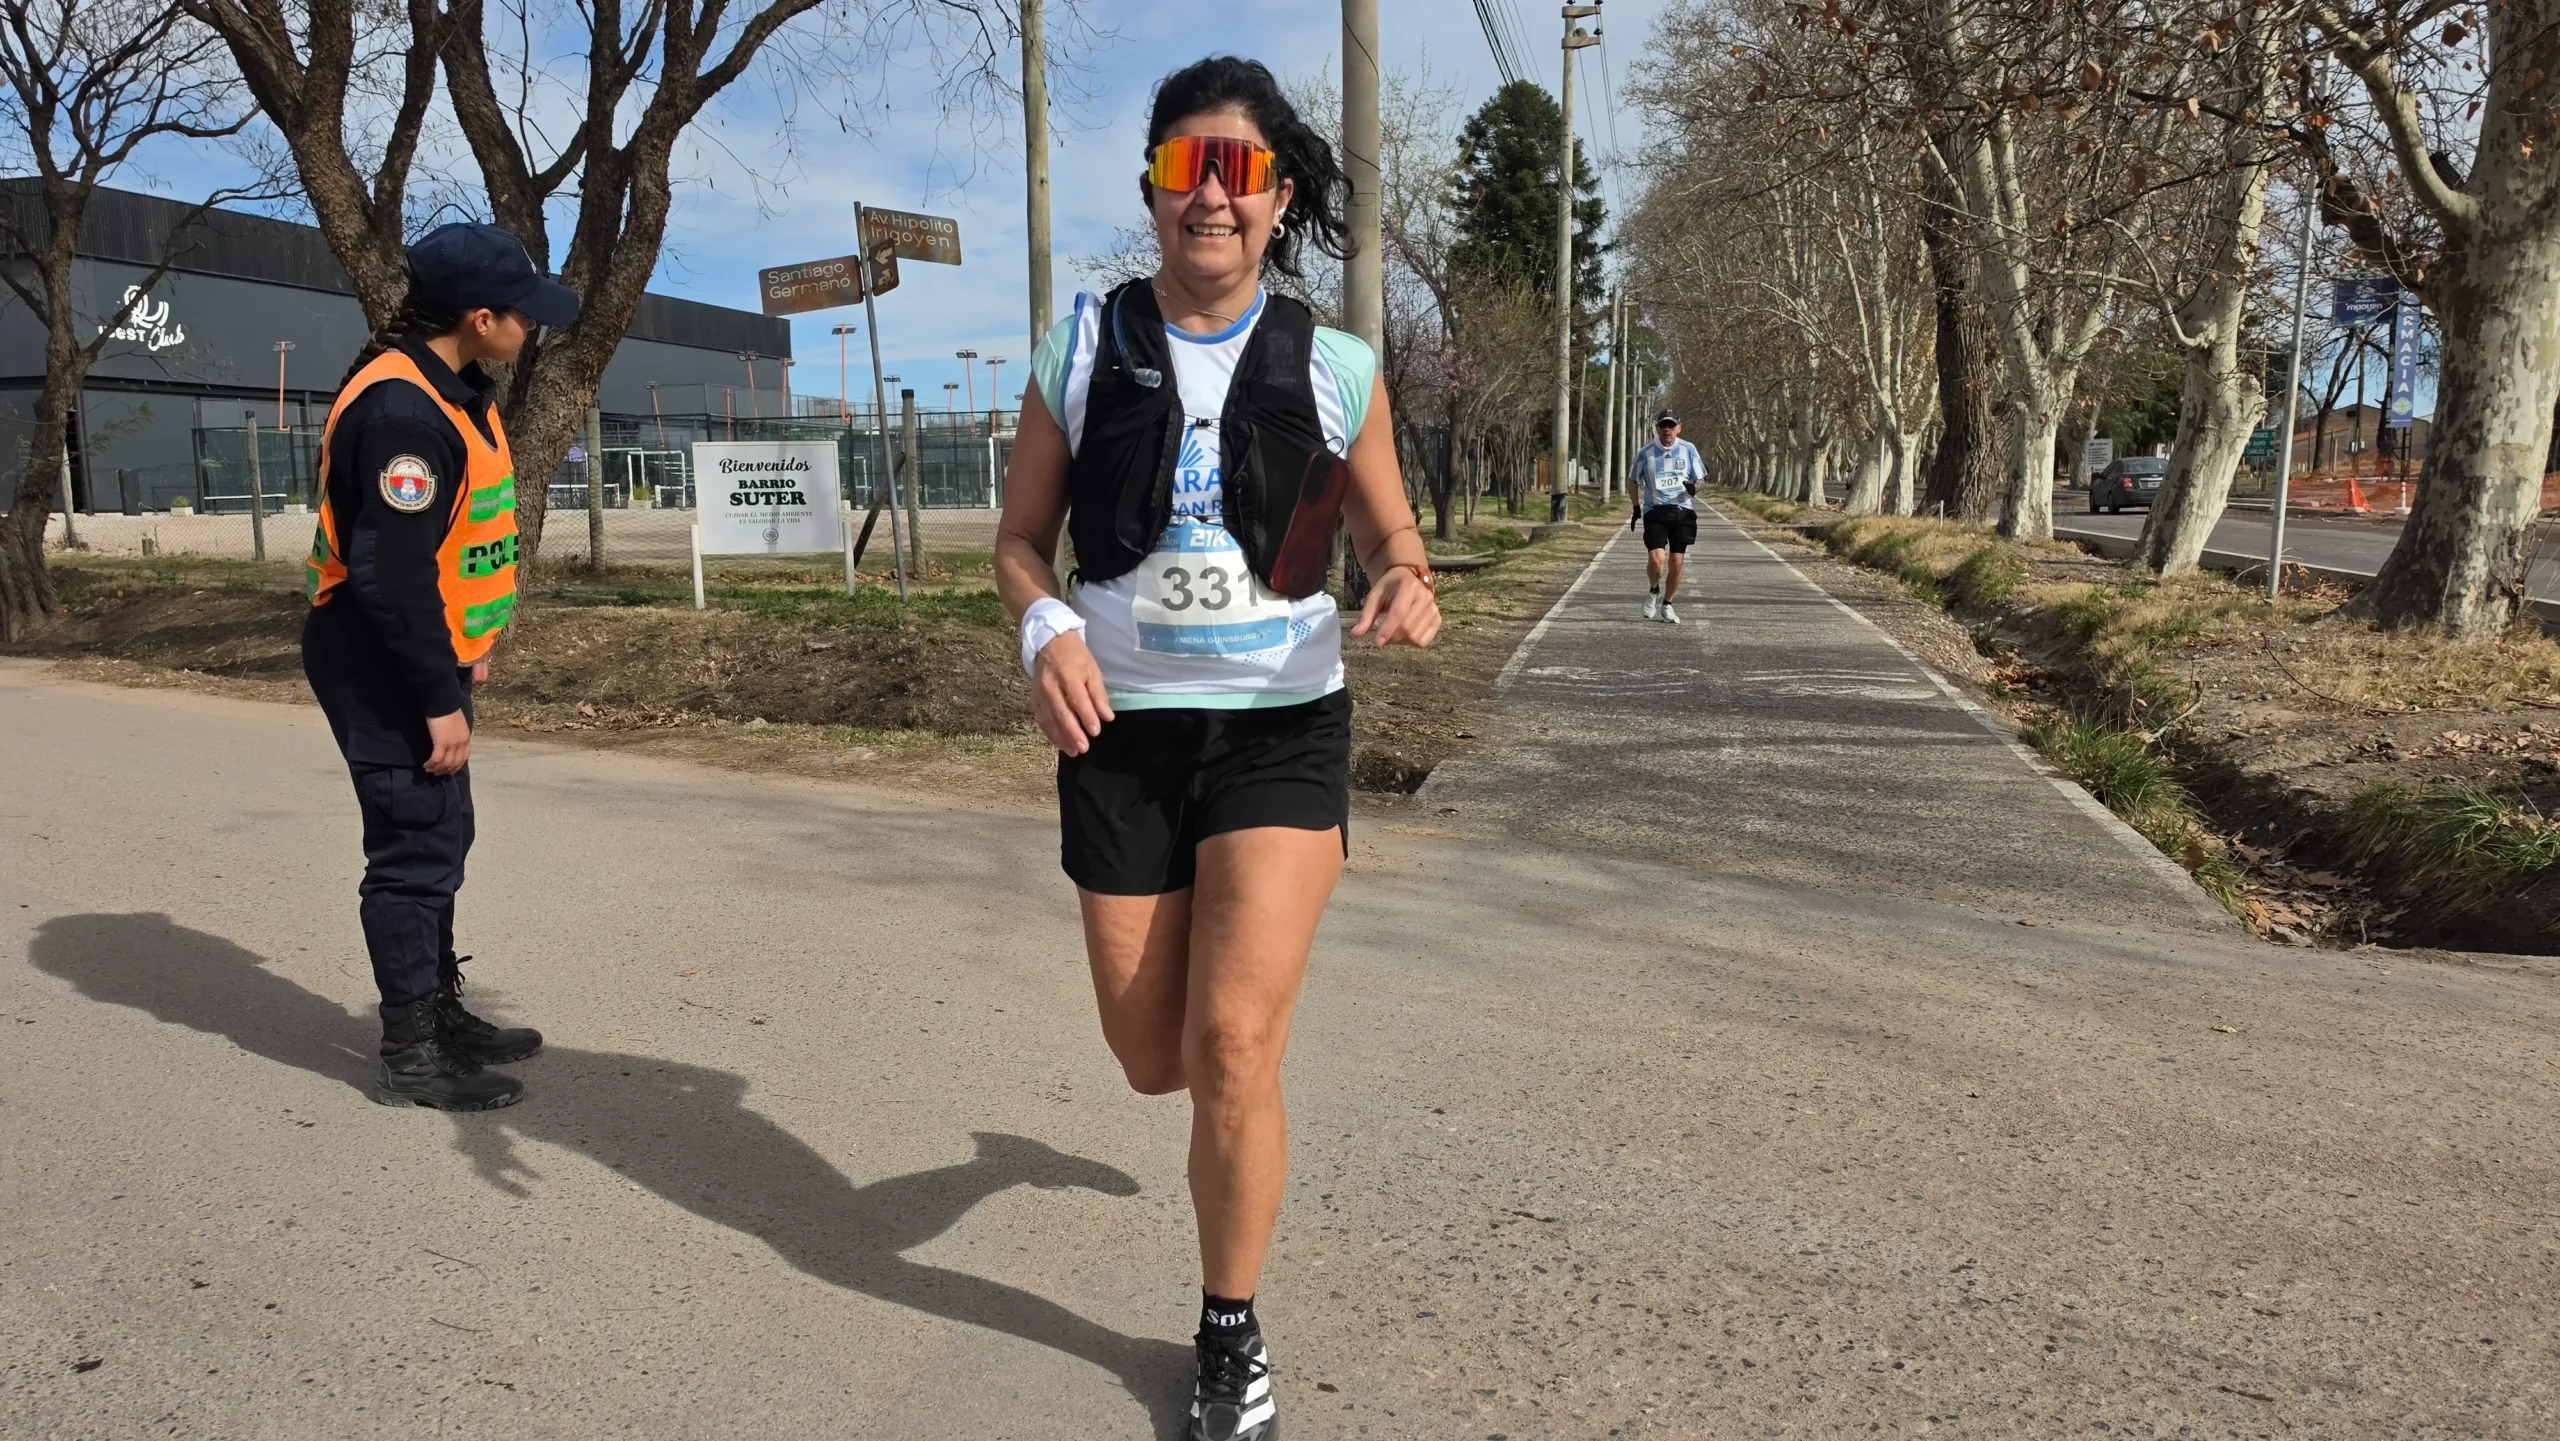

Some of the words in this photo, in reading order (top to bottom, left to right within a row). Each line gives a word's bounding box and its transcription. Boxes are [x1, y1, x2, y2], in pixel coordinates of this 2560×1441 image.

[870, 211, 888, 225] Av.
[892, 213, 953, 234] Hipolito
[870, 226, 950, 248] Irigoyen
[768, 263, 845, 284] Santiago
[769, 273, 851, 299] Germanó
[147, 323, 185, 352] Club
[719, 457, 812, 474] Bienvenidos
[738, 479, 796, 489] BARRIO
[1660, 477, 1679, 487] 207
[729, 491, 807, 506] SUTER
[1189, 529, 1229, 547] 21K
[1161, 566, 1258, 611] 331
[1173, 635, 1205, 644] JIMENA
[1207, 632, 1257, 644] GUINSBURG
